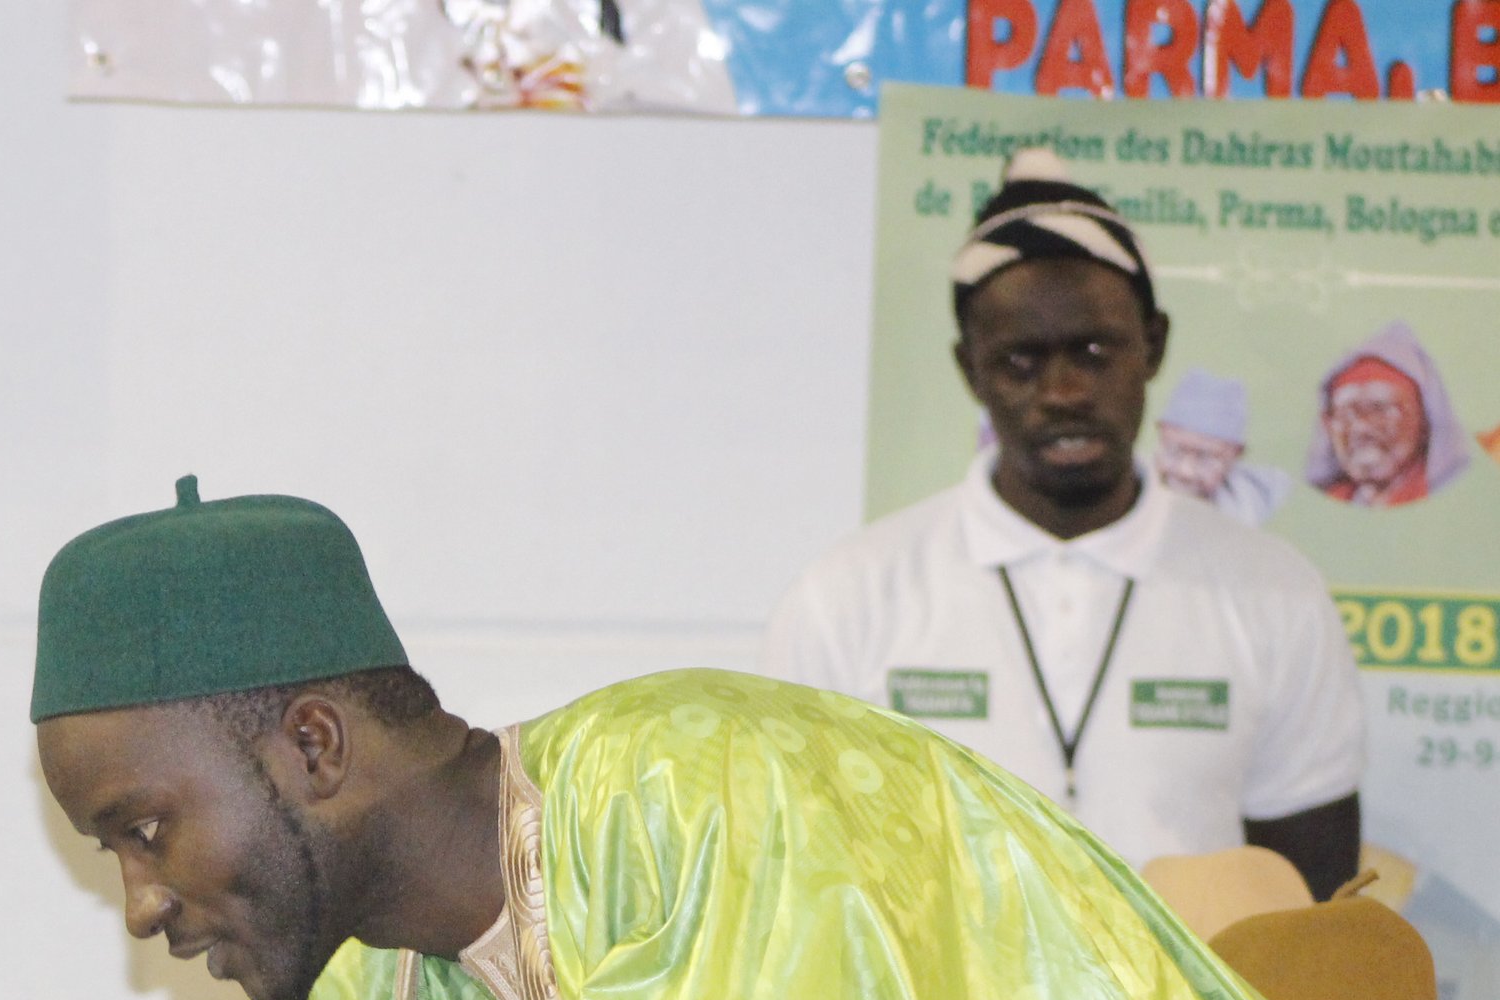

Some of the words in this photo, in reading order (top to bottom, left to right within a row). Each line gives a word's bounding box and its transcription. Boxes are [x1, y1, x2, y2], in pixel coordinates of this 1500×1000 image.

[1114, 127, 1169, 162] des
[1181, 128, 1314, 169] Dahiras
[914, 181, 951, 216] de
[1217, 188, 1334, 238] Parma,
[1346, 194, 1478, 243] Bologna
[1338, 601, 1497, 665] 2018
[1386, 685, 1500, 724] Reggio
